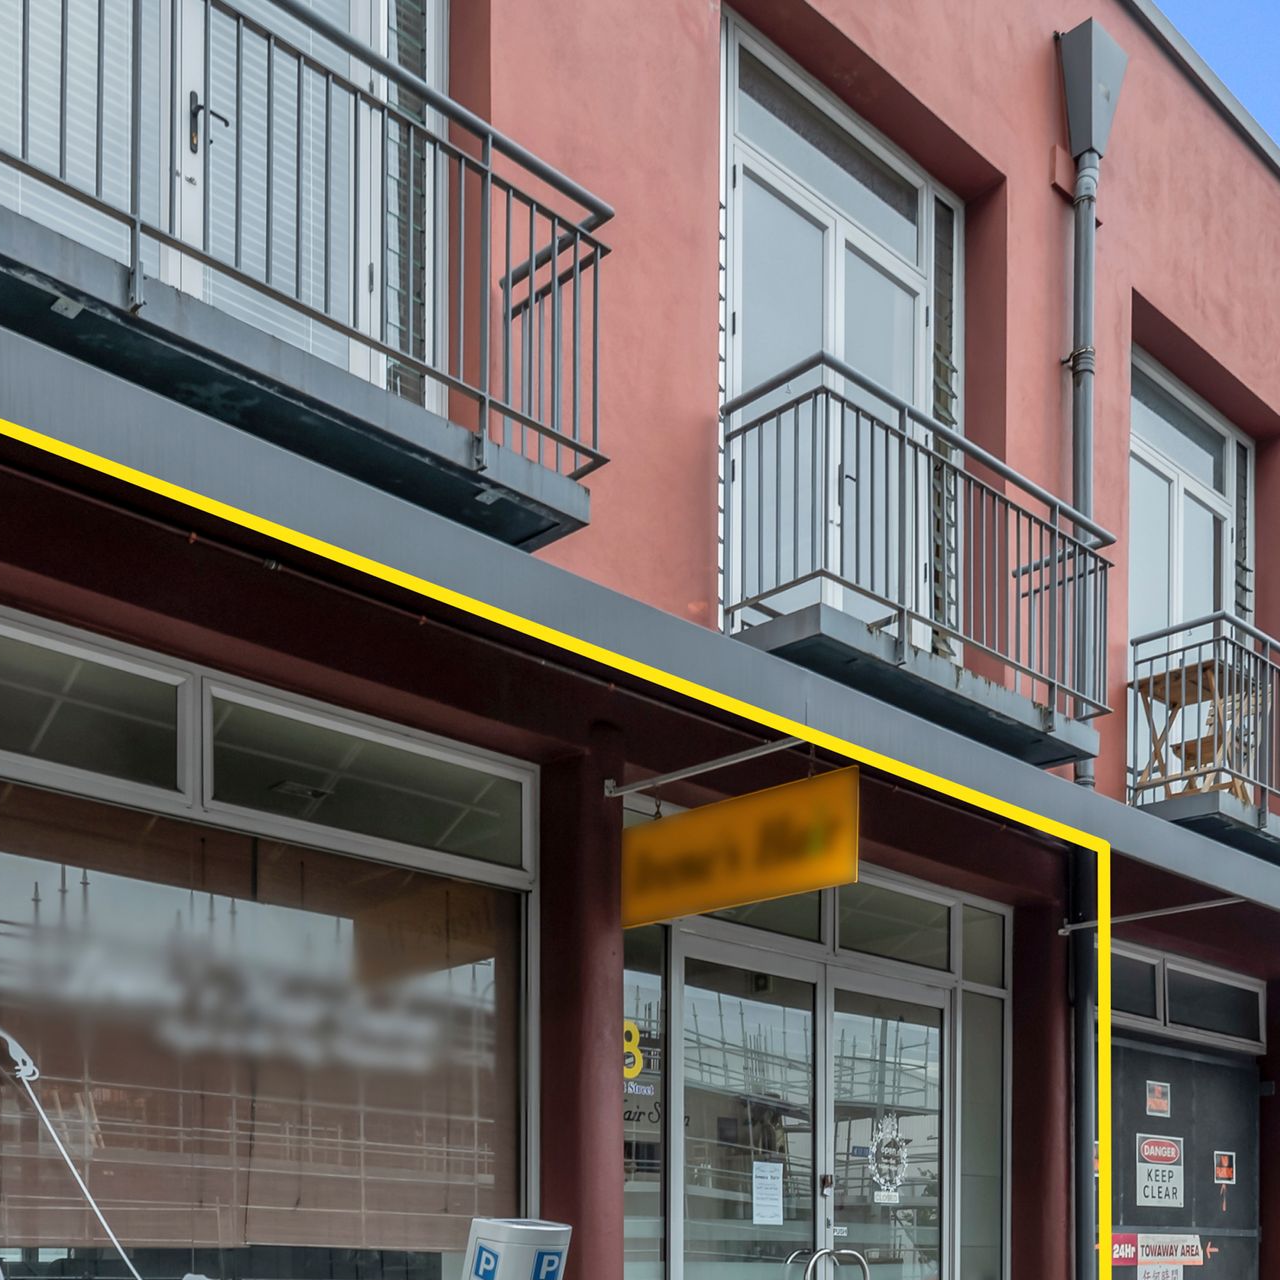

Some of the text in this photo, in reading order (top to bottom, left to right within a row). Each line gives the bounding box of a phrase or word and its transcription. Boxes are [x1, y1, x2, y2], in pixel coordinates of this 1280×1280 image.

[1143, 1145, 1176, 1158] DANGER
[1147, 1168, 1174, 1183] KEEP
[1143, 1185, 1178, 1200] CLEAR
[1113, 1243, 1200, 1259] 24Hr TOWAWAY AREA
[479, 1250, 495, 1276] P
[539, 1255, 559, 1280] P
